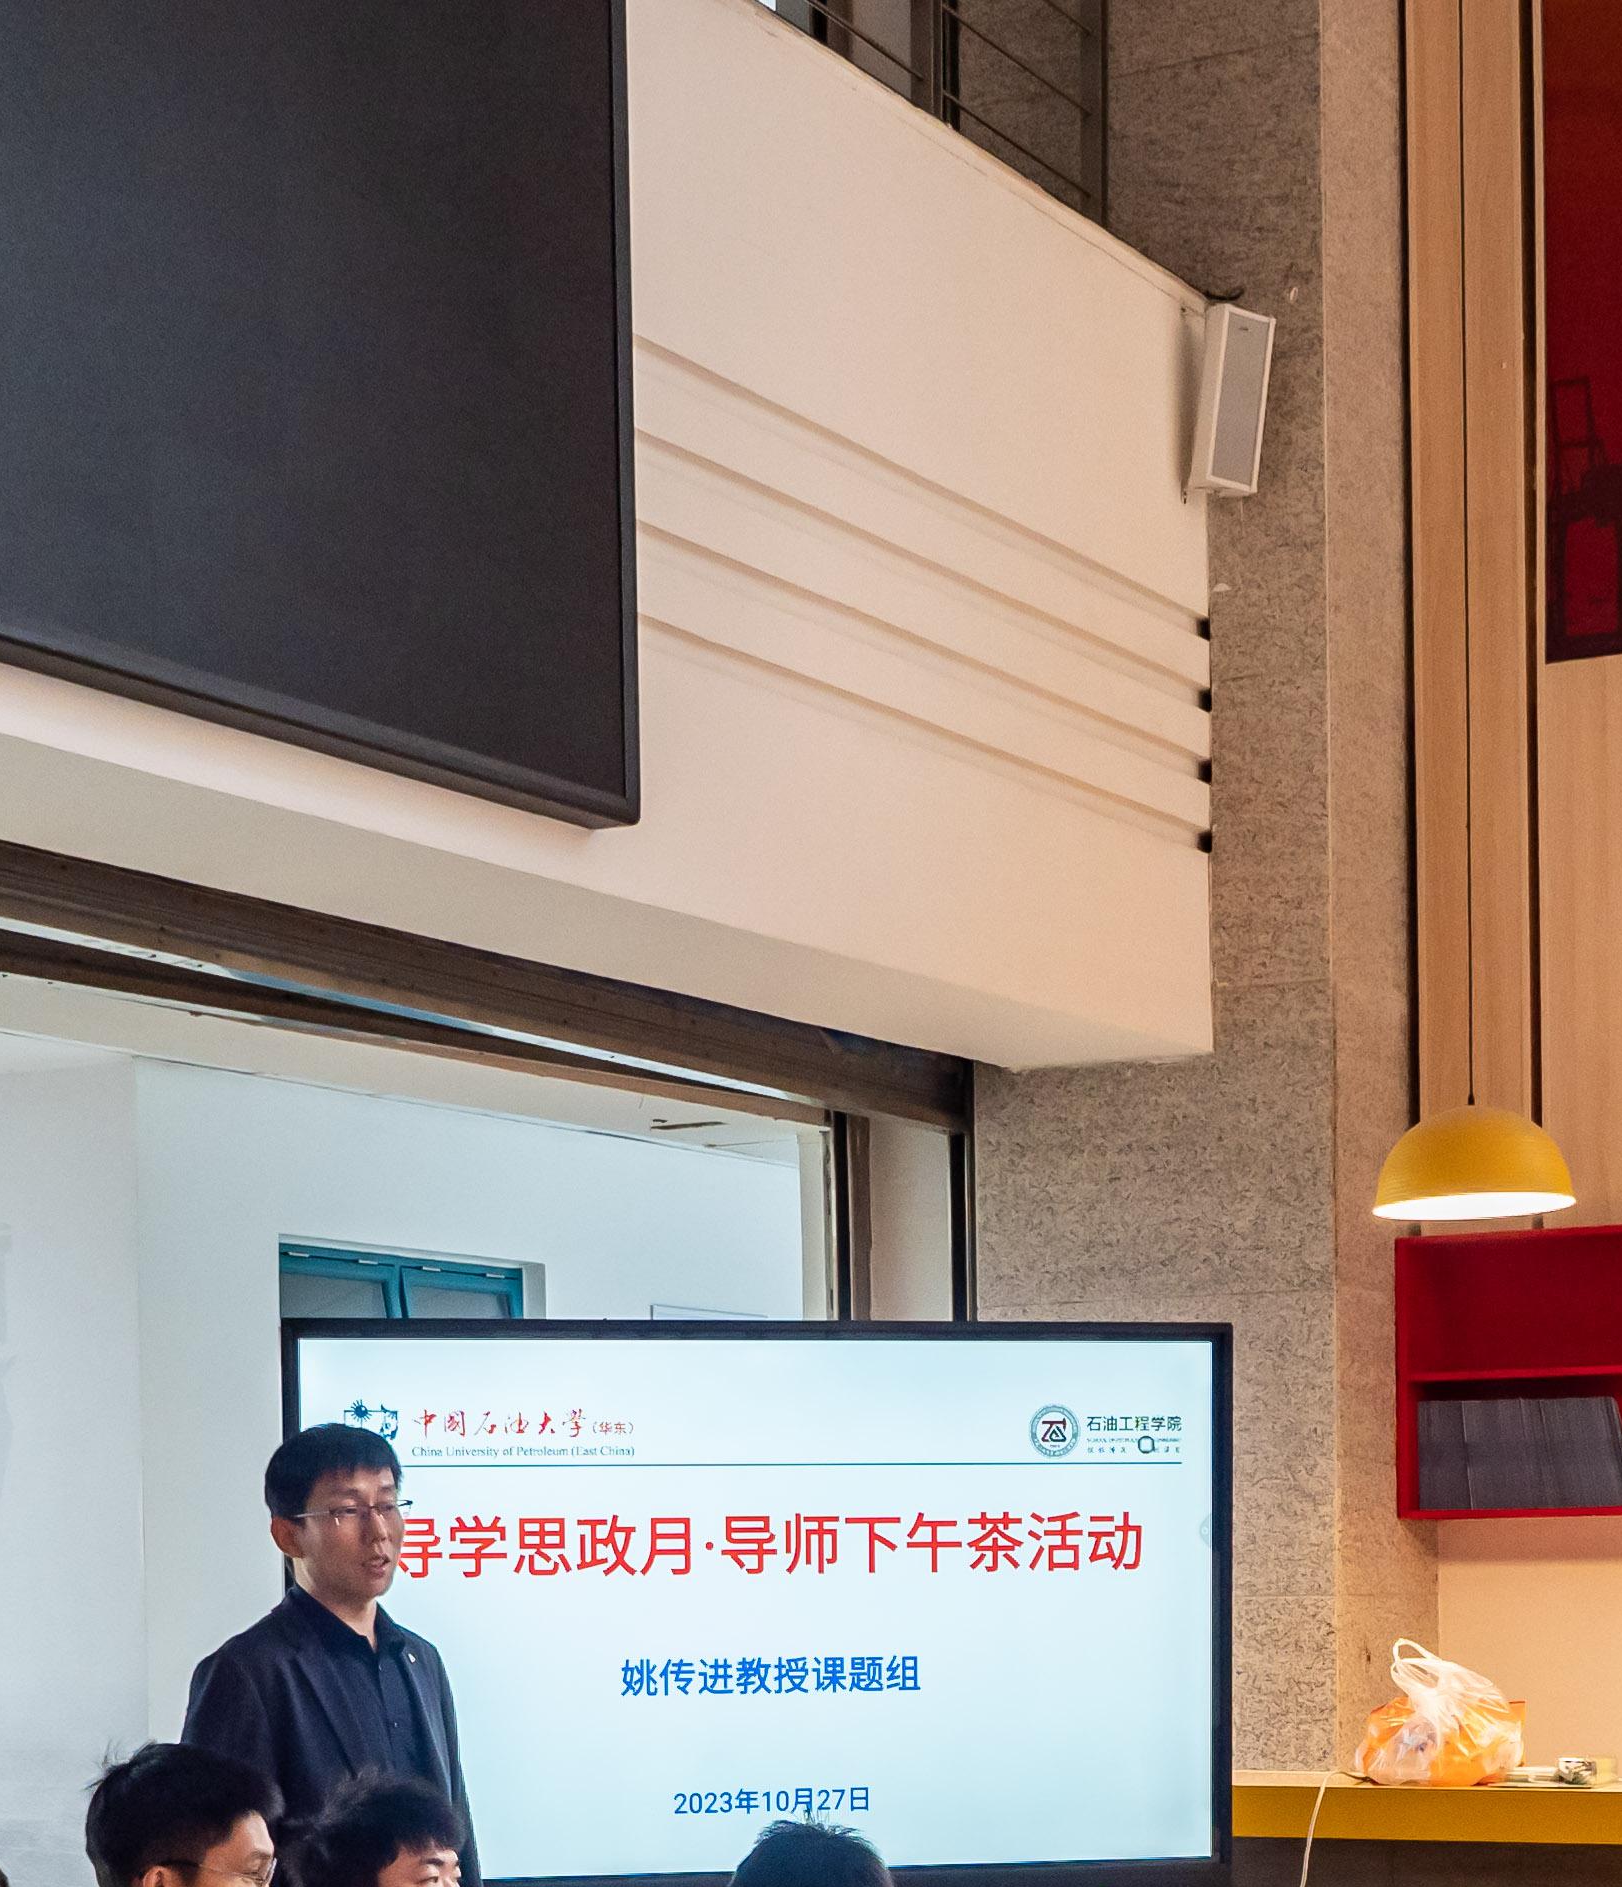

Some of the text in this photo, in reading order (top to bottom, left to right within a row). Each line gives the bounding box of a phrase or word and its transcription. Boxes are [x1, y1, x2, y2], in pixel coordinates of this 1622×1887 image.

[1086, 1415, 1183, 1432] 石油工程学院
[411, 1445, 635, 1460] China University of Petroleum (East China)
[621, 1655, 921, 1697] 姚传进教授课题组
[673, 1786, 870, 1814] 2023年10月27日
